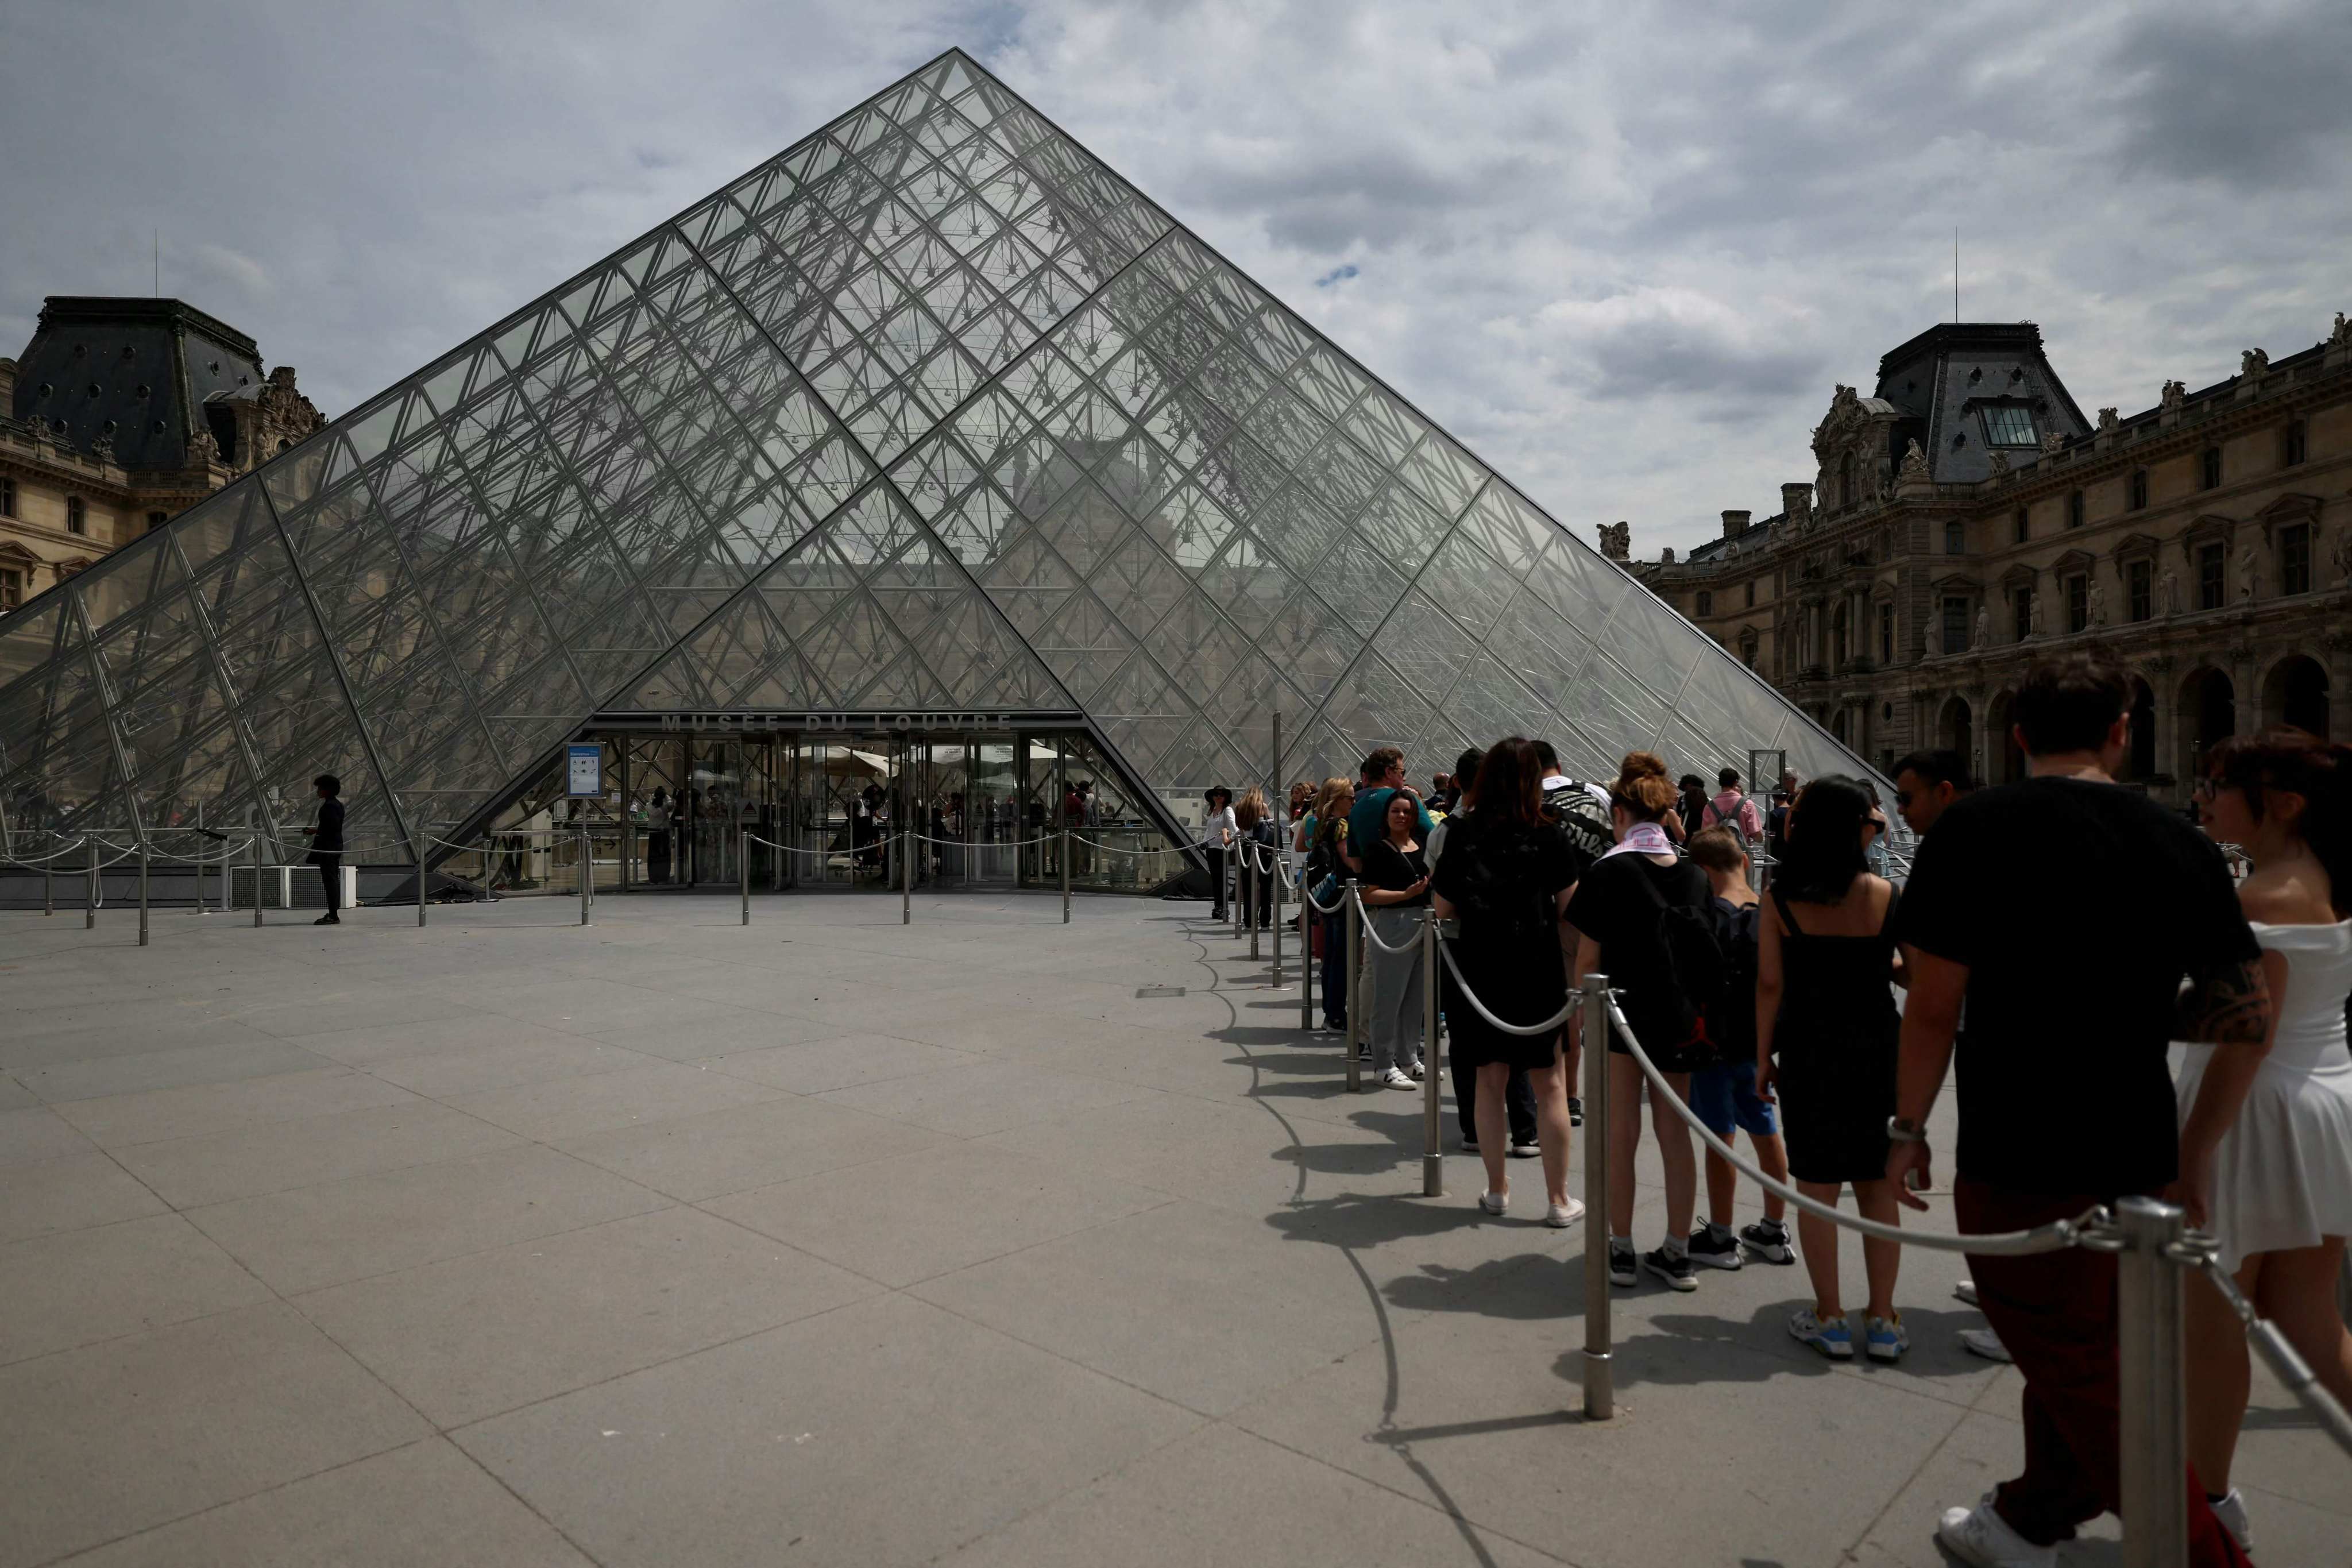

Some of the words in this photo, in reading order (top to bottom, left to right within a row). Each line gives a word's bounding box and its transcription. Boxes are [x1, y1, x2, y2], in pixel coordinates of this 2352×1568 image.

[662, 711, 778, 731] MUSÉE
[806, 715, 847, 731] DU
[875, 714, 1010, 731] LOUVRE
